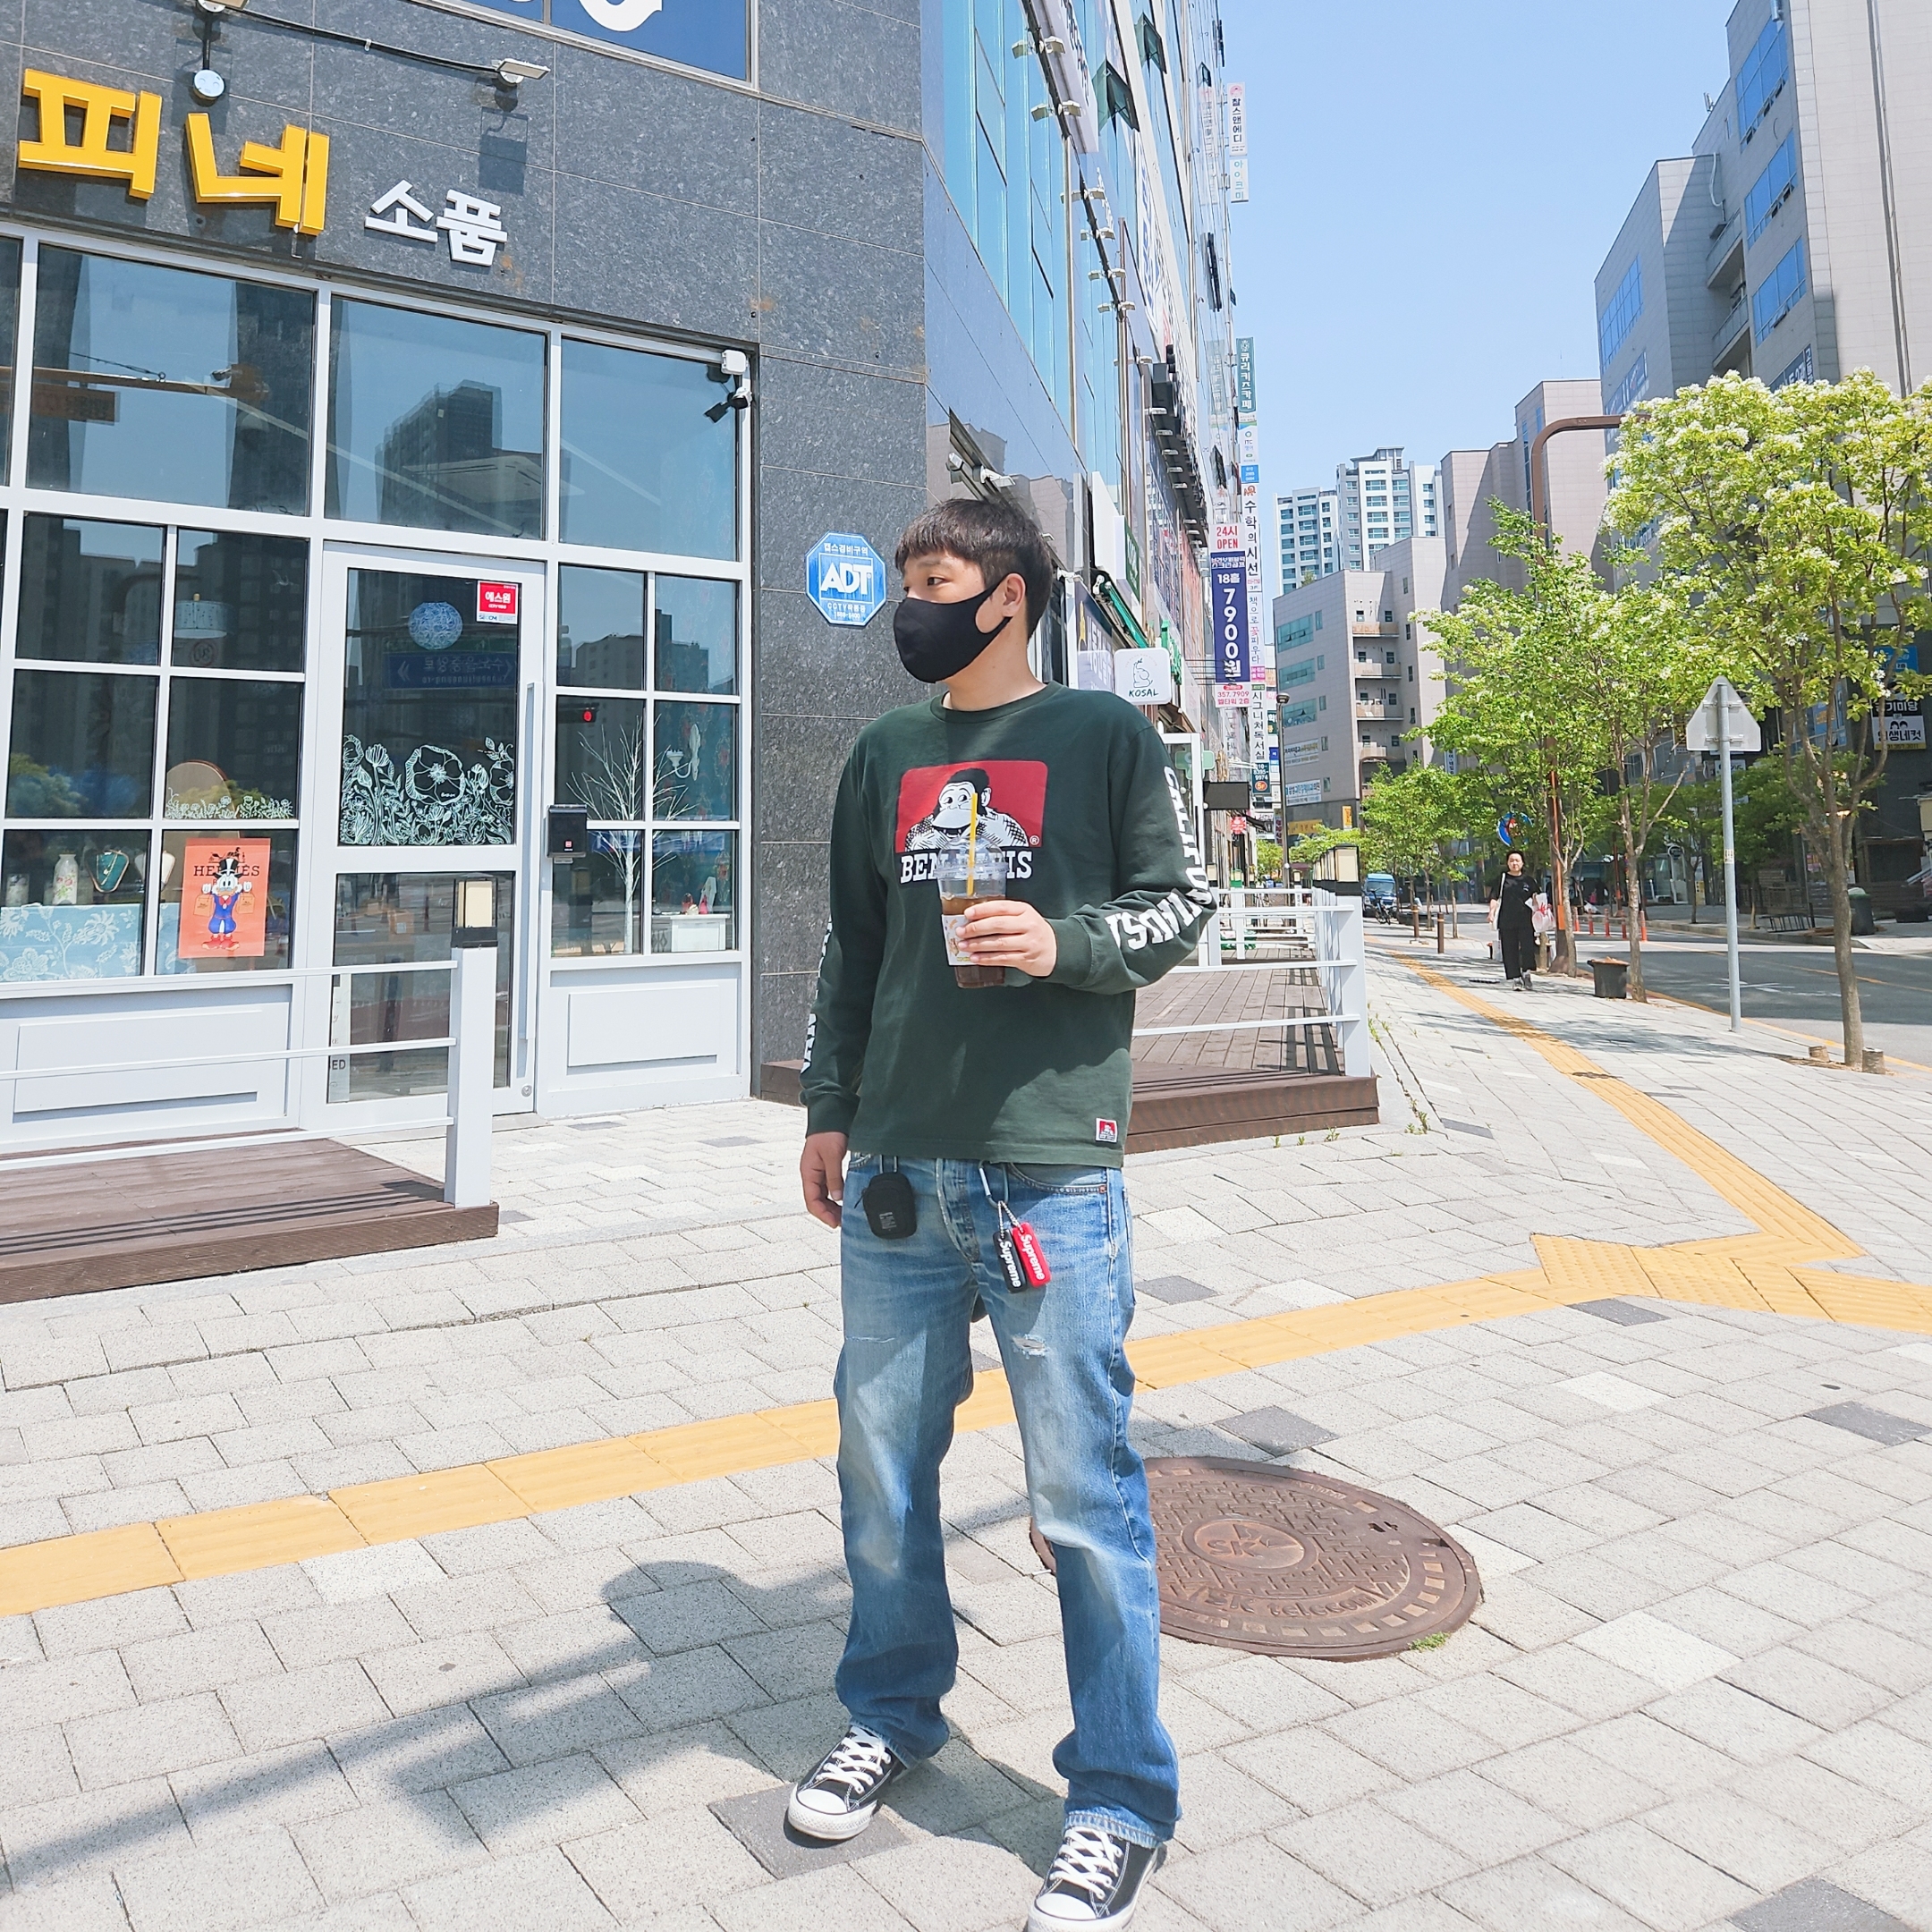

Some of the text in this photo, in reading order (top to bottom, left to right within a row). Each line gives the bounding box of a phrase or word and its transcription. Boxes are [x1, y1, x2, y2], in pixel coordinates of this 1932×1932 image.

[18, 68, 508, 267] 피네 소품
[1216, 526, 1238, 537] 24시
[1244, 500, 1258, 577] 수학의시선
[1217, 538, 1238, 550] OPEN
[820, 562, 873, 596] ADT
[1217, 573, 1241, 584] 18홀
[485, 591, 511, 604] 에스원
[1129, 689, 1159, 698] KOSAL
[1252, 691, 1266, 760] 시그니처독서실
[999, 1240, 1021, 1288] Supreme
[1021, 1233, 1046, 1281] Supreme
[1207, 1538, 1258, 1559] SK
[1267, 1593, 1378, 1617] telecom
